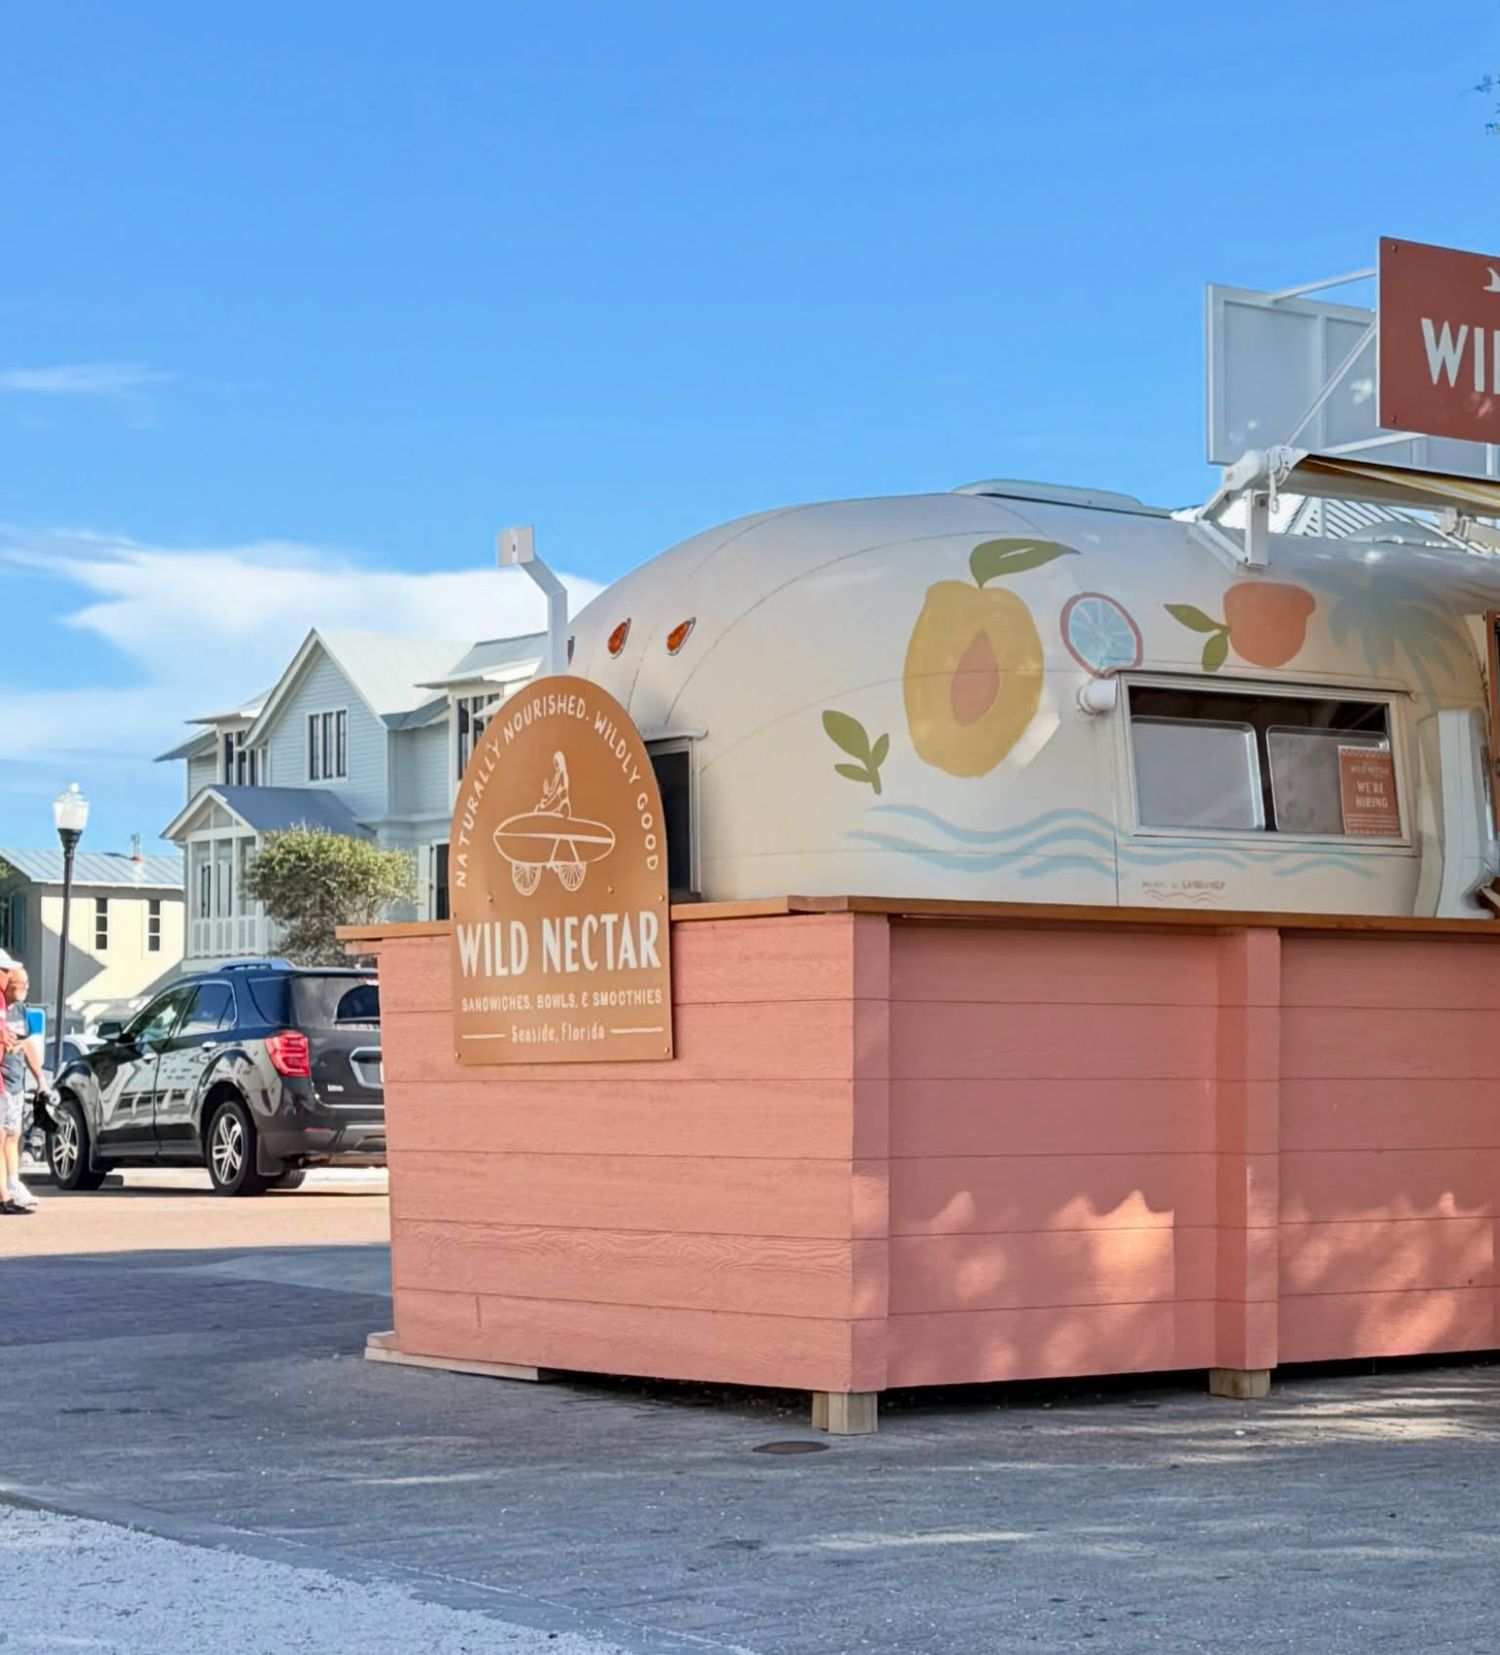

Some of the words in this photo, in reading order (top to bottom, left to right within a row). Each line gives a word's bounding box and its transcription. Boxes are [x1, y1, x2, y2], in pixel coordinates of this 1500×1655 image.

[455, 739, 500, 888] NATURALLY
[593, 710, 642, 785] WILDLY
[636, 791, 659, 871] GOOD
[456, 921, 529, 979] WILD
[541, 910, 662, 975] NECTAR
[592, 988, 663, 1006] SMOOTHIES
[511, 1024, 560, 1044] Seaside,
[561, 1021, 605, 1042] Florida
